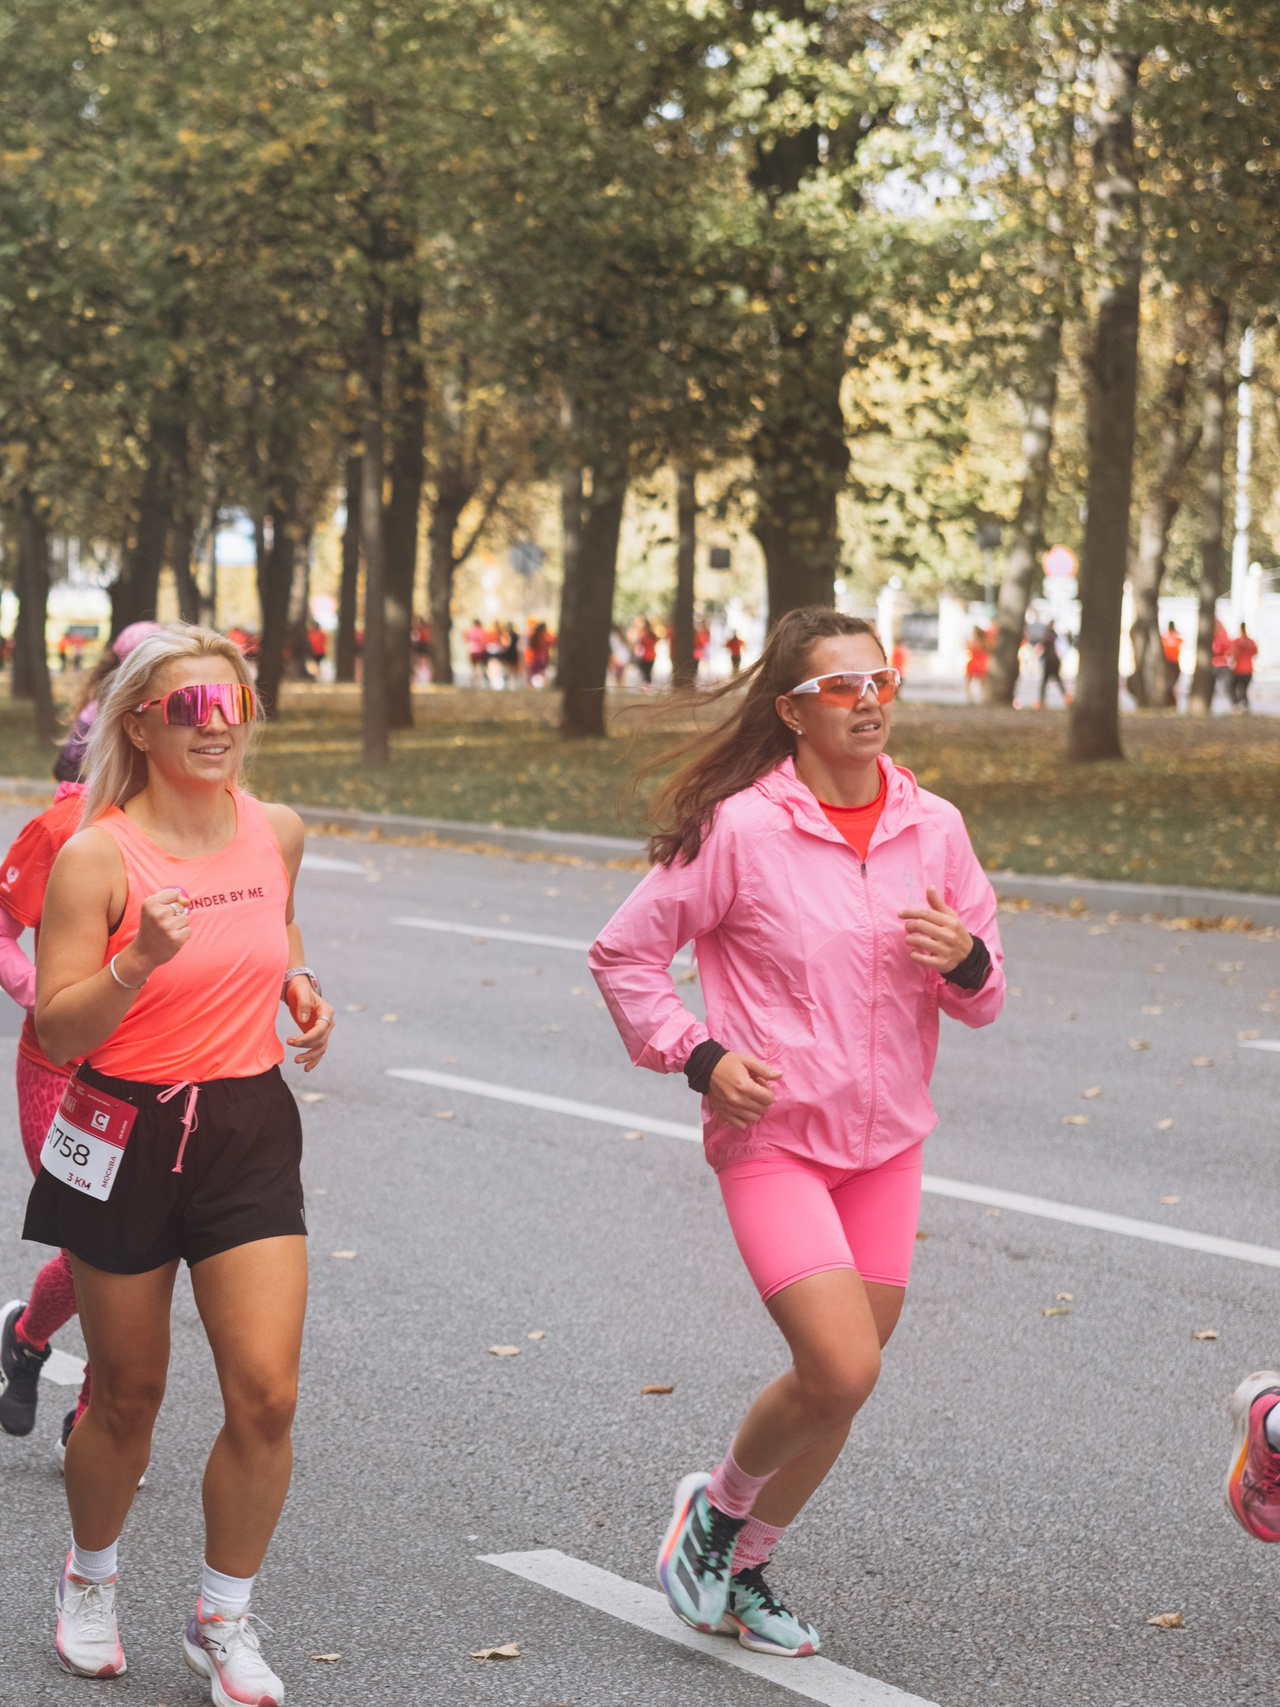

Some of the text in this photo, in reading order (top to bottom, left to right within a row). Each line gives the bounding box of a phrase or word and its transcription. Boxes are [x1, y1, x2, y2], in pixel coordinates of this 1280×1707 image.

[229, 889, 244, 902] BY
[248, 887, 264, 899] ME
[95, 1113, 107, 1126] C
[66, 1172, 74, 1182] 3
[101, 1156, 117, 1188] МОСКВА
